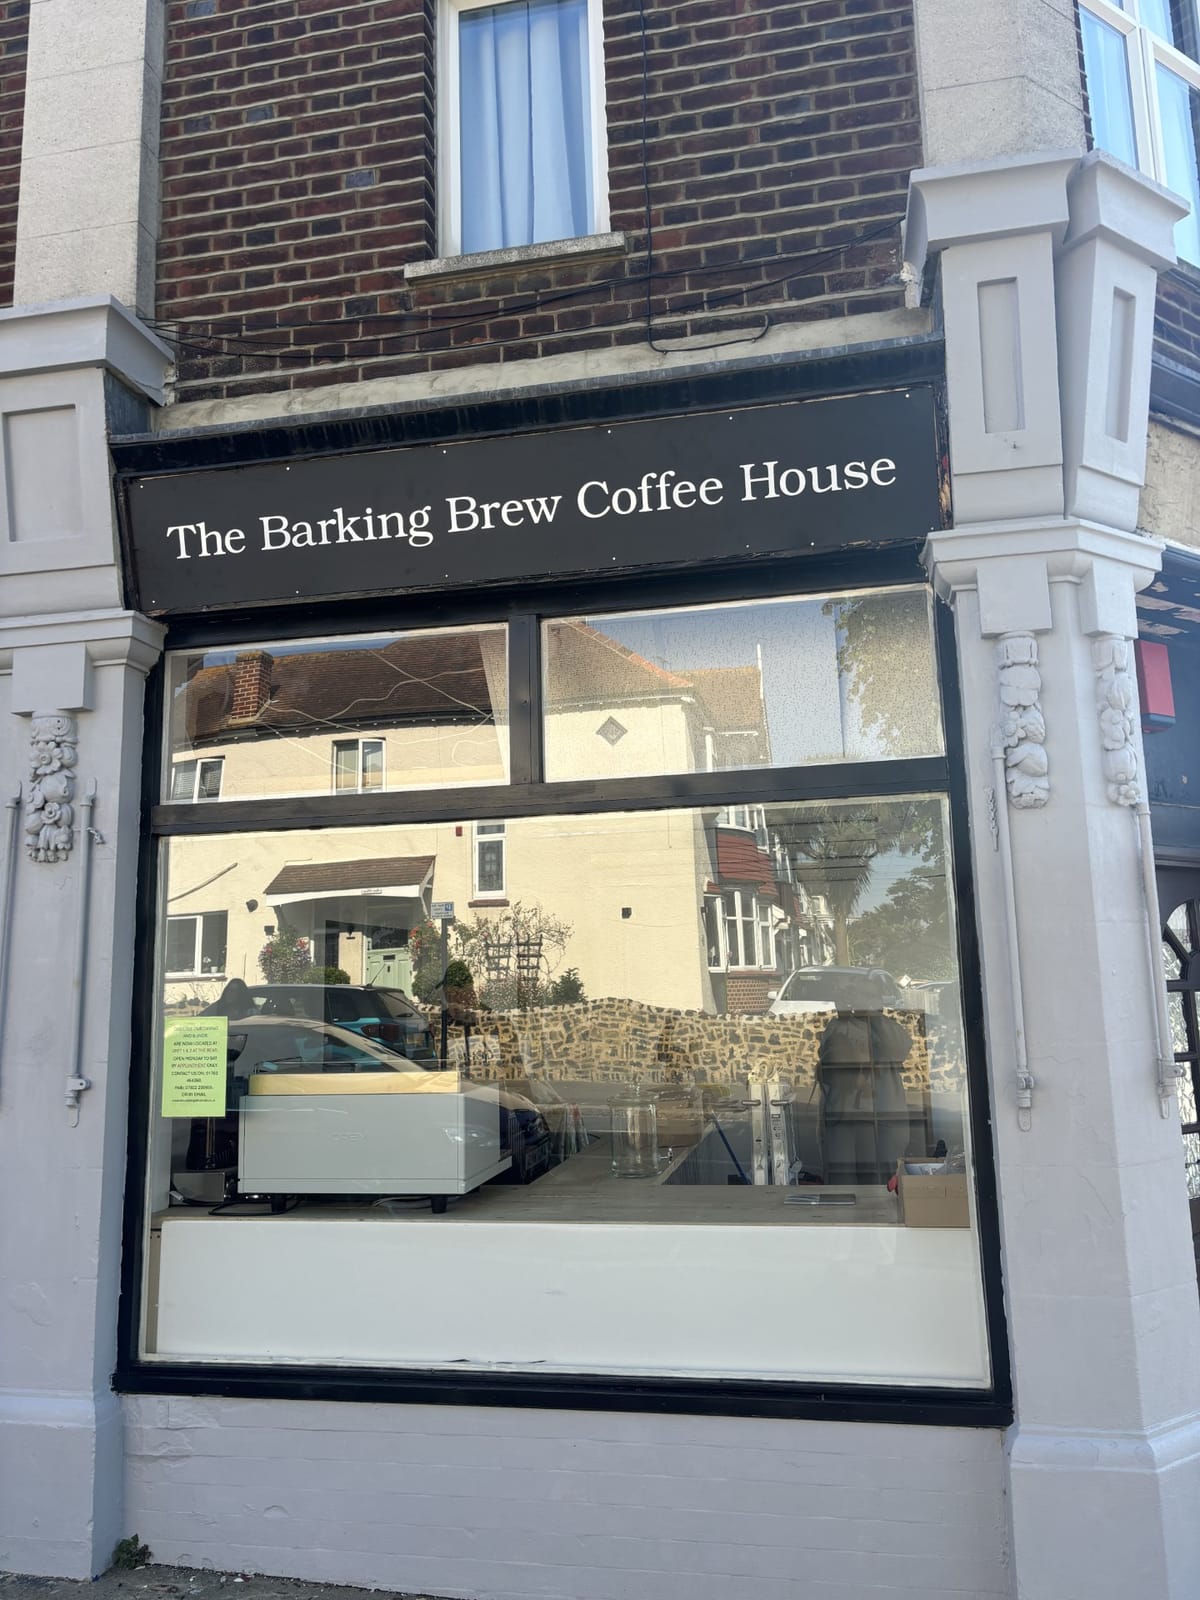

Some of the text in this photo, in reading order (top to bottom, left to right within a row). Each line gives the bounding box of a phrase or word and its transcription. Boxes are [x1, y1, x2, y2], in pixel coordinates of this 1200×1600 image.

[166, 458, 897, 560] The Barking Brew Coffee House
